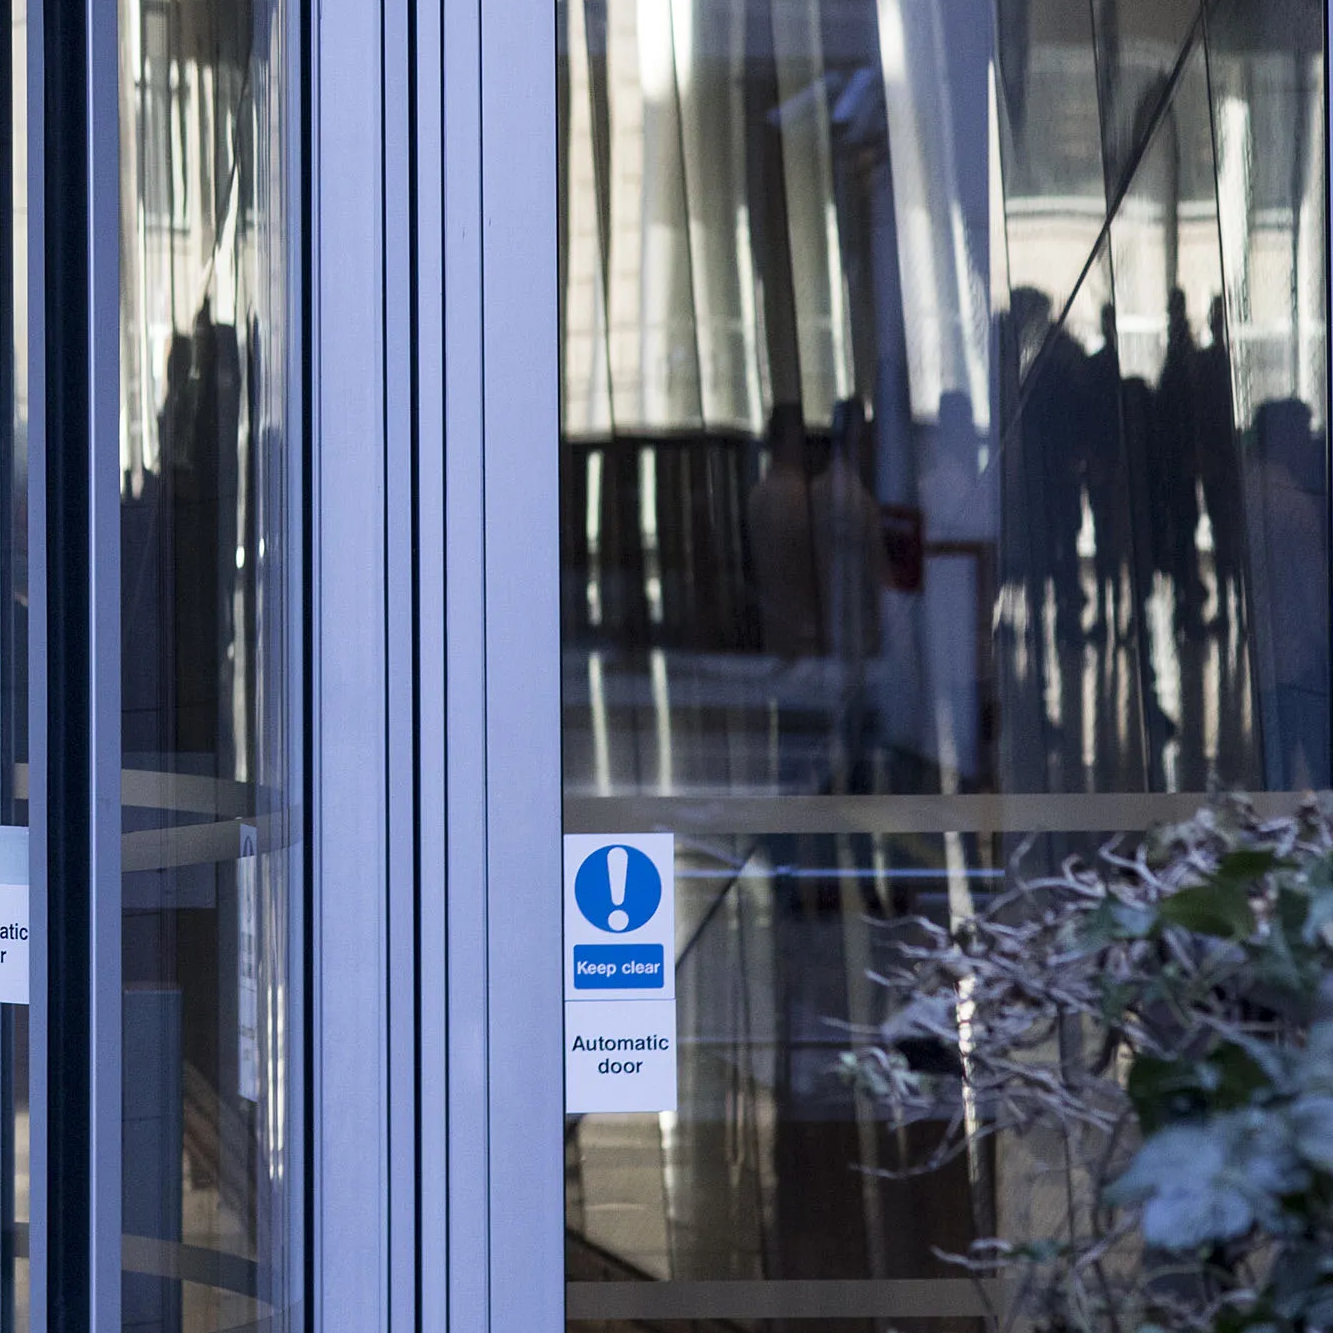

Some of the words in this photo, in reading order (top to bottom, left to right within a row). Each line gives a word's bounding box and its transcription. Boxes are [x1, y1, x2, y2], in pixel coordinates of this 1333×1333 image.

[576, 960, 617, 978] Keep
[621, 960, 661, 974] clear
[571, 1034, 670, 1052] Automatic
[597, 1057, 644, 1075] door
